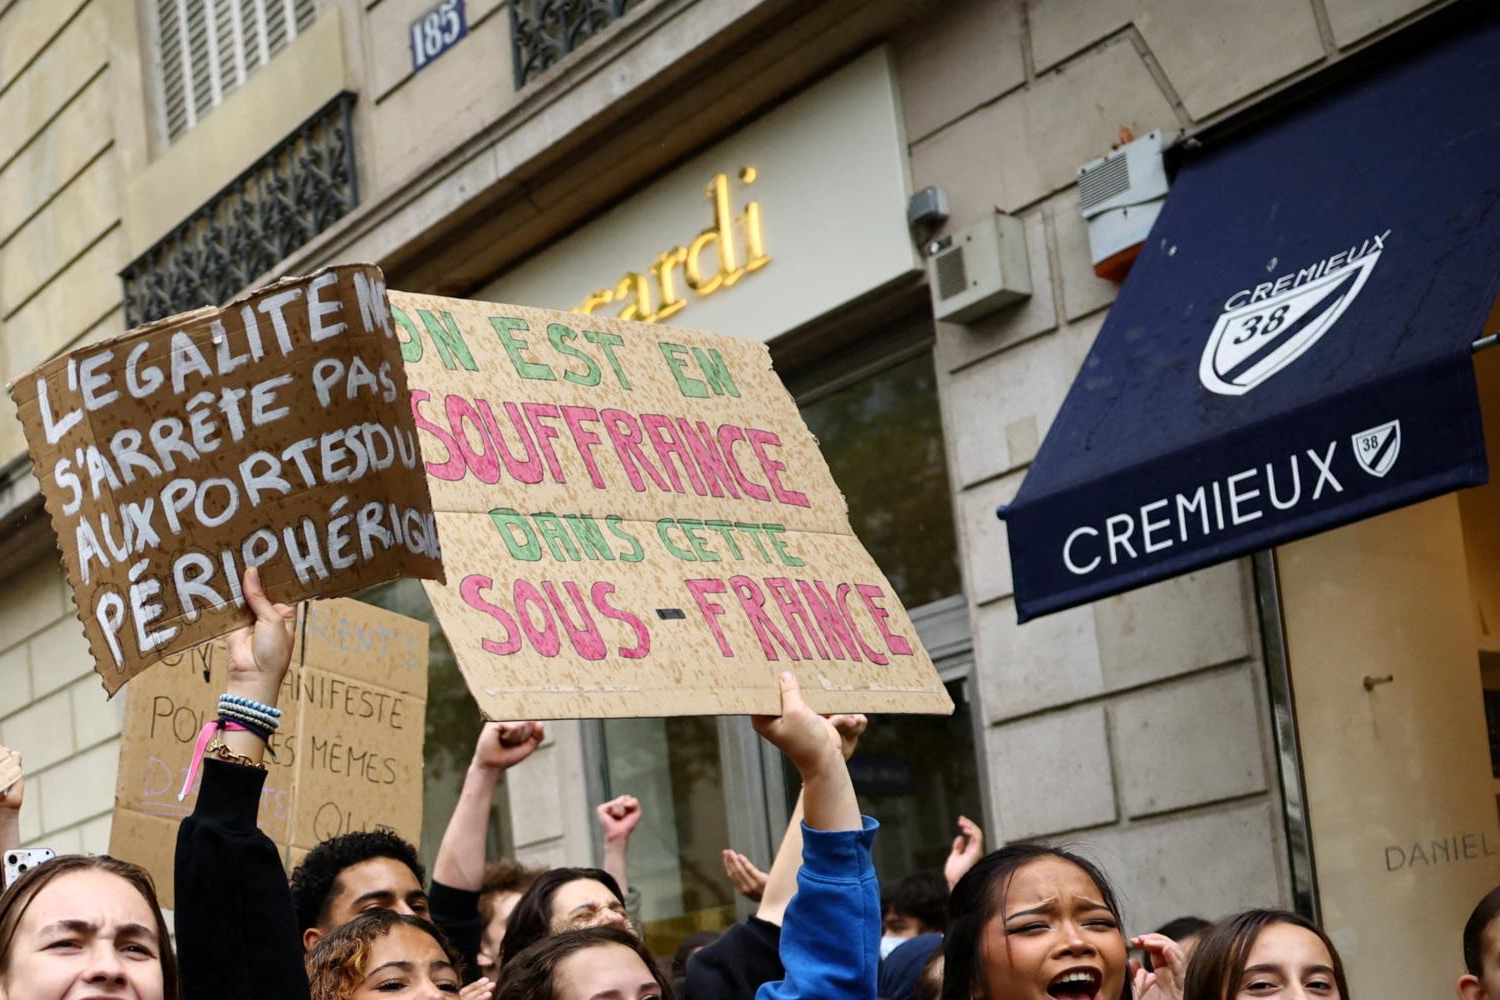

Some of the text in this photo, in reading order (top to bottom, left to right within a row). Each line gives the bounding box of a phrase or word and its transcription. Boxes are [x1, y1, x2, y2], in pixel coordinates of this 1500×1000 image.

[412, 0, 461, 66] 185
[1224, 229, 1392, 312] CREMIEUX
[488, 316, 633, 391] EST
[658, 342, 742, 399] EN
[1232, 304, 1292, 346] 38
[36, 271, 348, 446] L'EGALITE
[53, 355, 397, 517] S'ARRÊTE PAS
[410, 388, 812, 508] SOUFFRANCE
[1361, 435, 1380, 452] 38
[75, 421, 417, 586] AUX PORTES DU
[1062, 440, 1344, 576] CREMIEUX
[487, 507, 806, 568] DANS CETTE
[309, 607, 421, 670] RENTS
[280, 668, 409, 730] ANIFESTÉ
[261, 732, 296, 767] ES
[311, 733, 397, 785] MÊMES
[1384, 831, 1497, 872] DANIEL
